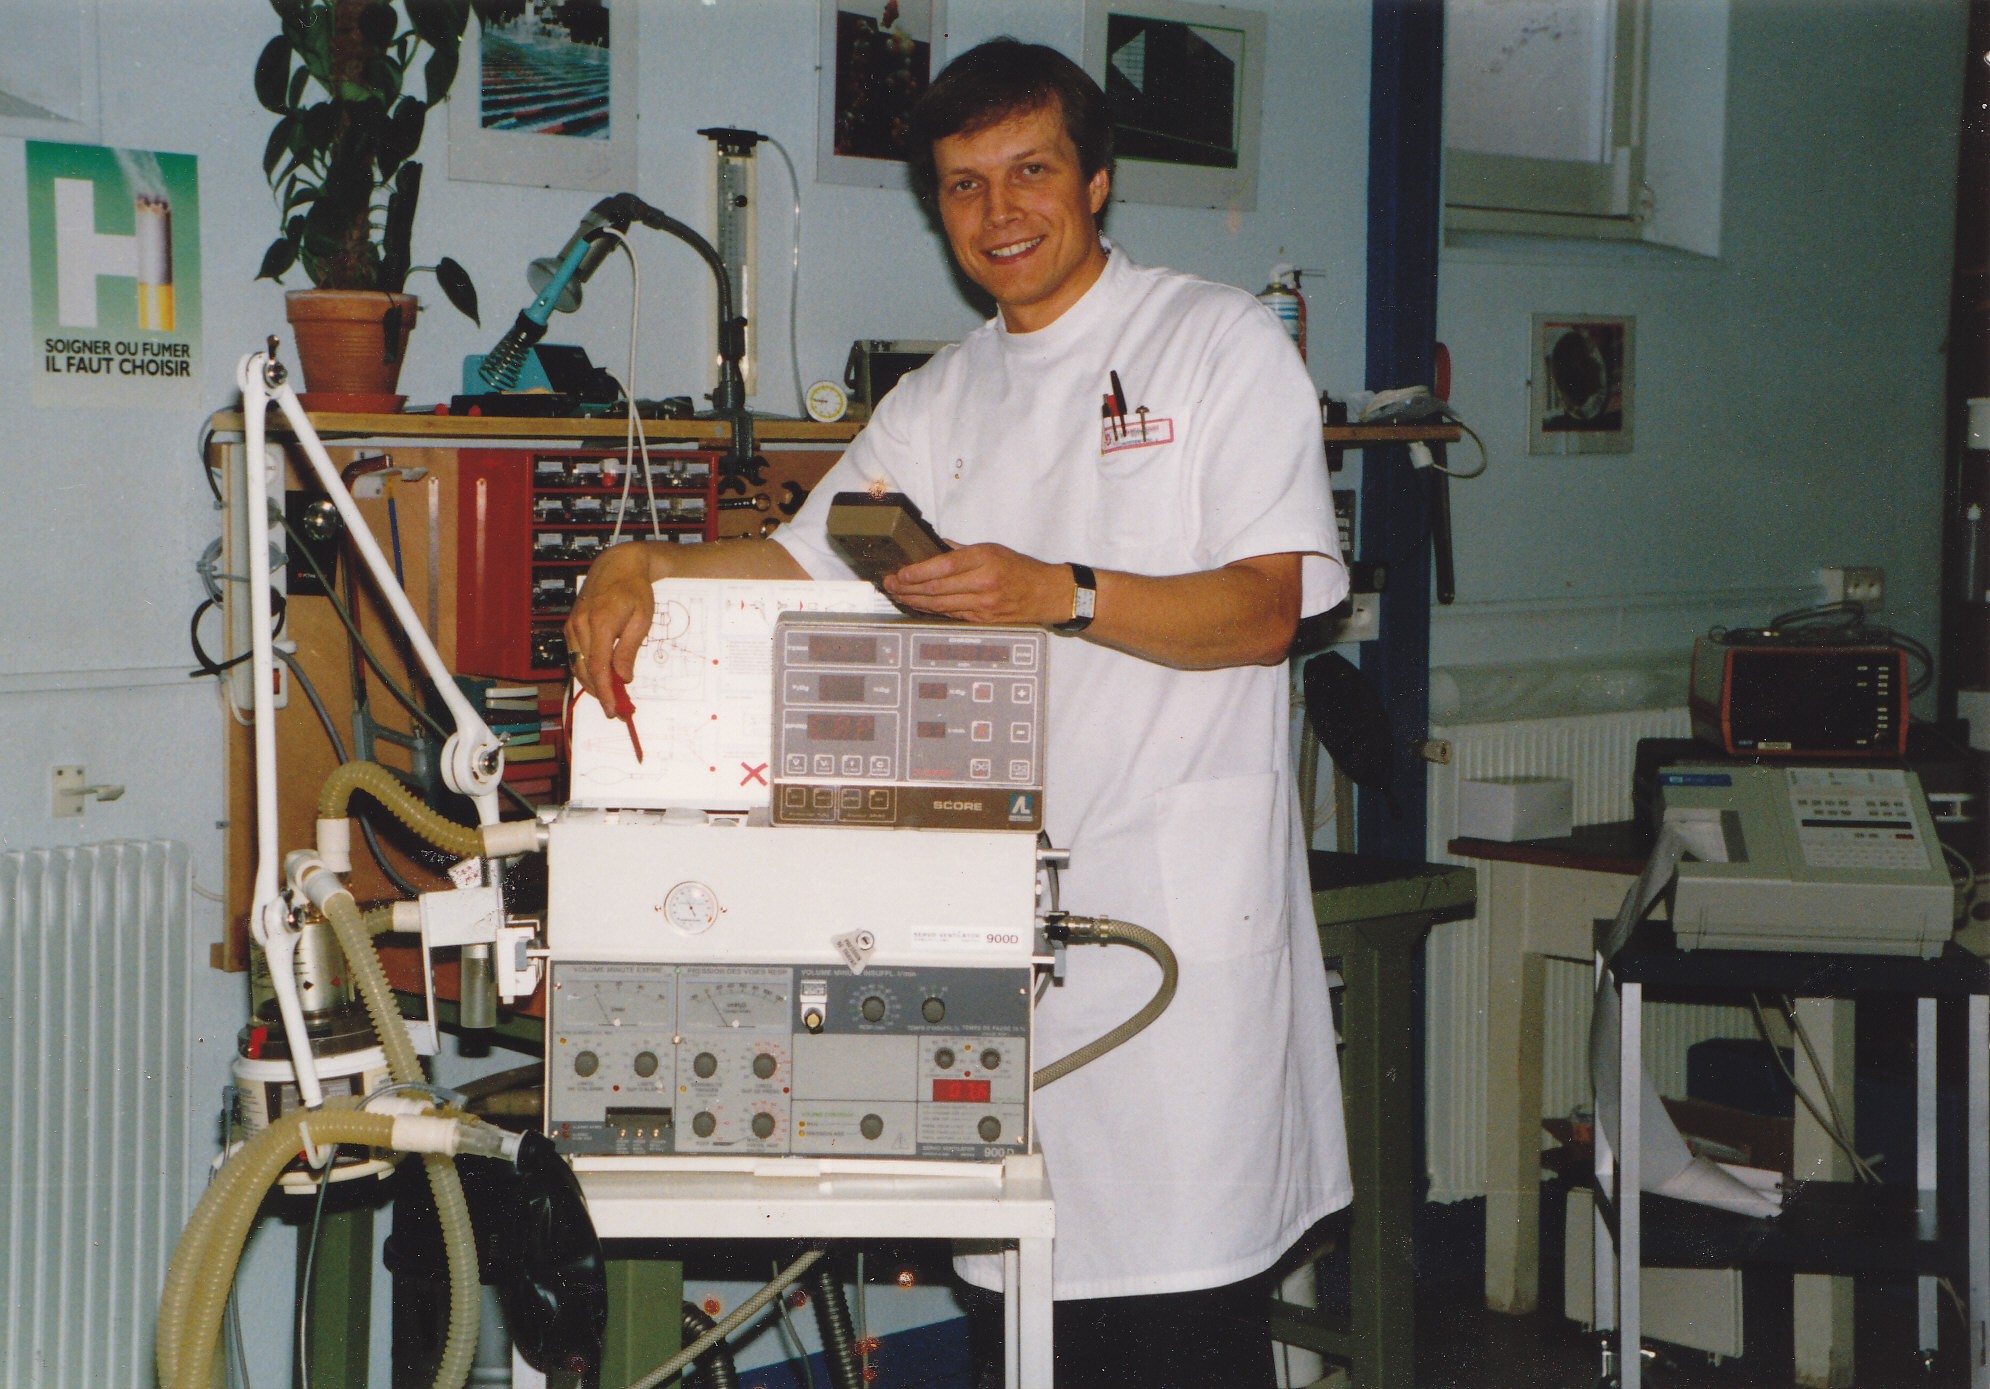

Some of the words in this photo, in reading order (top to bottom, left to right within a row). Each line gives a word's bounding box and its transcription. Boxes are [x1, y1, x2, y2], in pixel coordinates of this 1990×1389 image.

[45, 338, 112, 356] SOIGNER
[114, 341, 139, 357] OU
[141, 342, 191, 359] FUMER
[45, 355, 62, 373] IL
[66, 356, 114, 375] FAUT
[118, 358, 191, 377] CHOISIR
[933, 800, 983, 812] SCORE
[986, 933, 1019, 944] 900D
